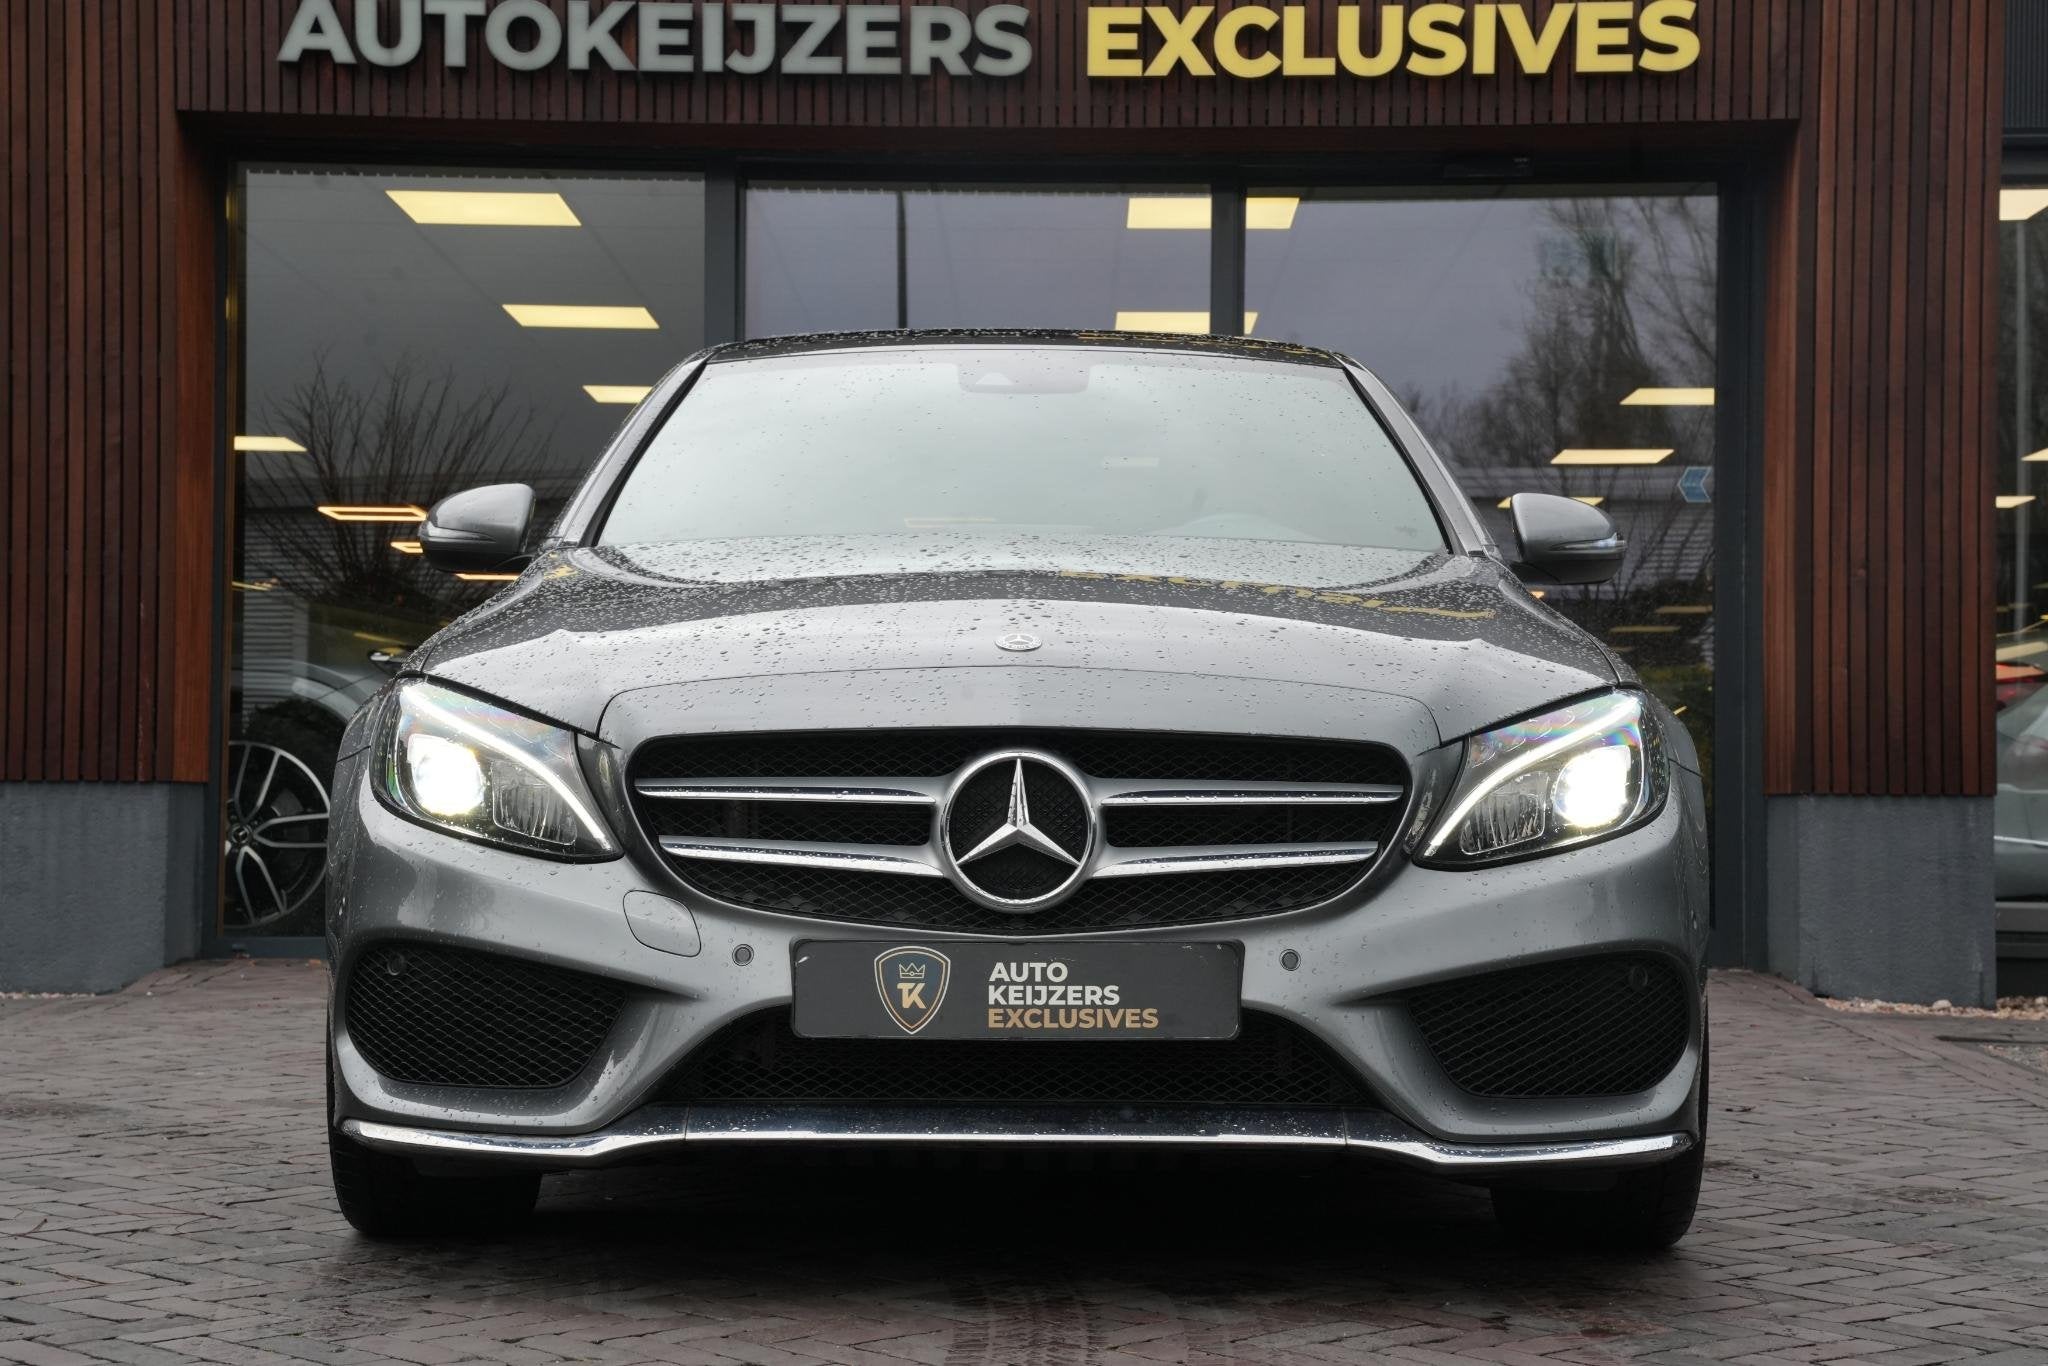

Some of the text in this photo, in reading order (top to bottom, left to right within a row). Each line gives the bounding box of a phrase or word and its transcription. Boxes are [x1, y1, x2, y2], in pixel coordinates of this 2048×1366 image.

[277, 0, 1701, 78] AUTOKEIJZERS EXCLUSIVES
[988, 961, 1069, 983] AUTO
[896, 982, 927, 1009] TK
[988, 985, 1121, 1006] KEIJZERS
[988, 1008, 1159, 1029] EXCLUSIVES
